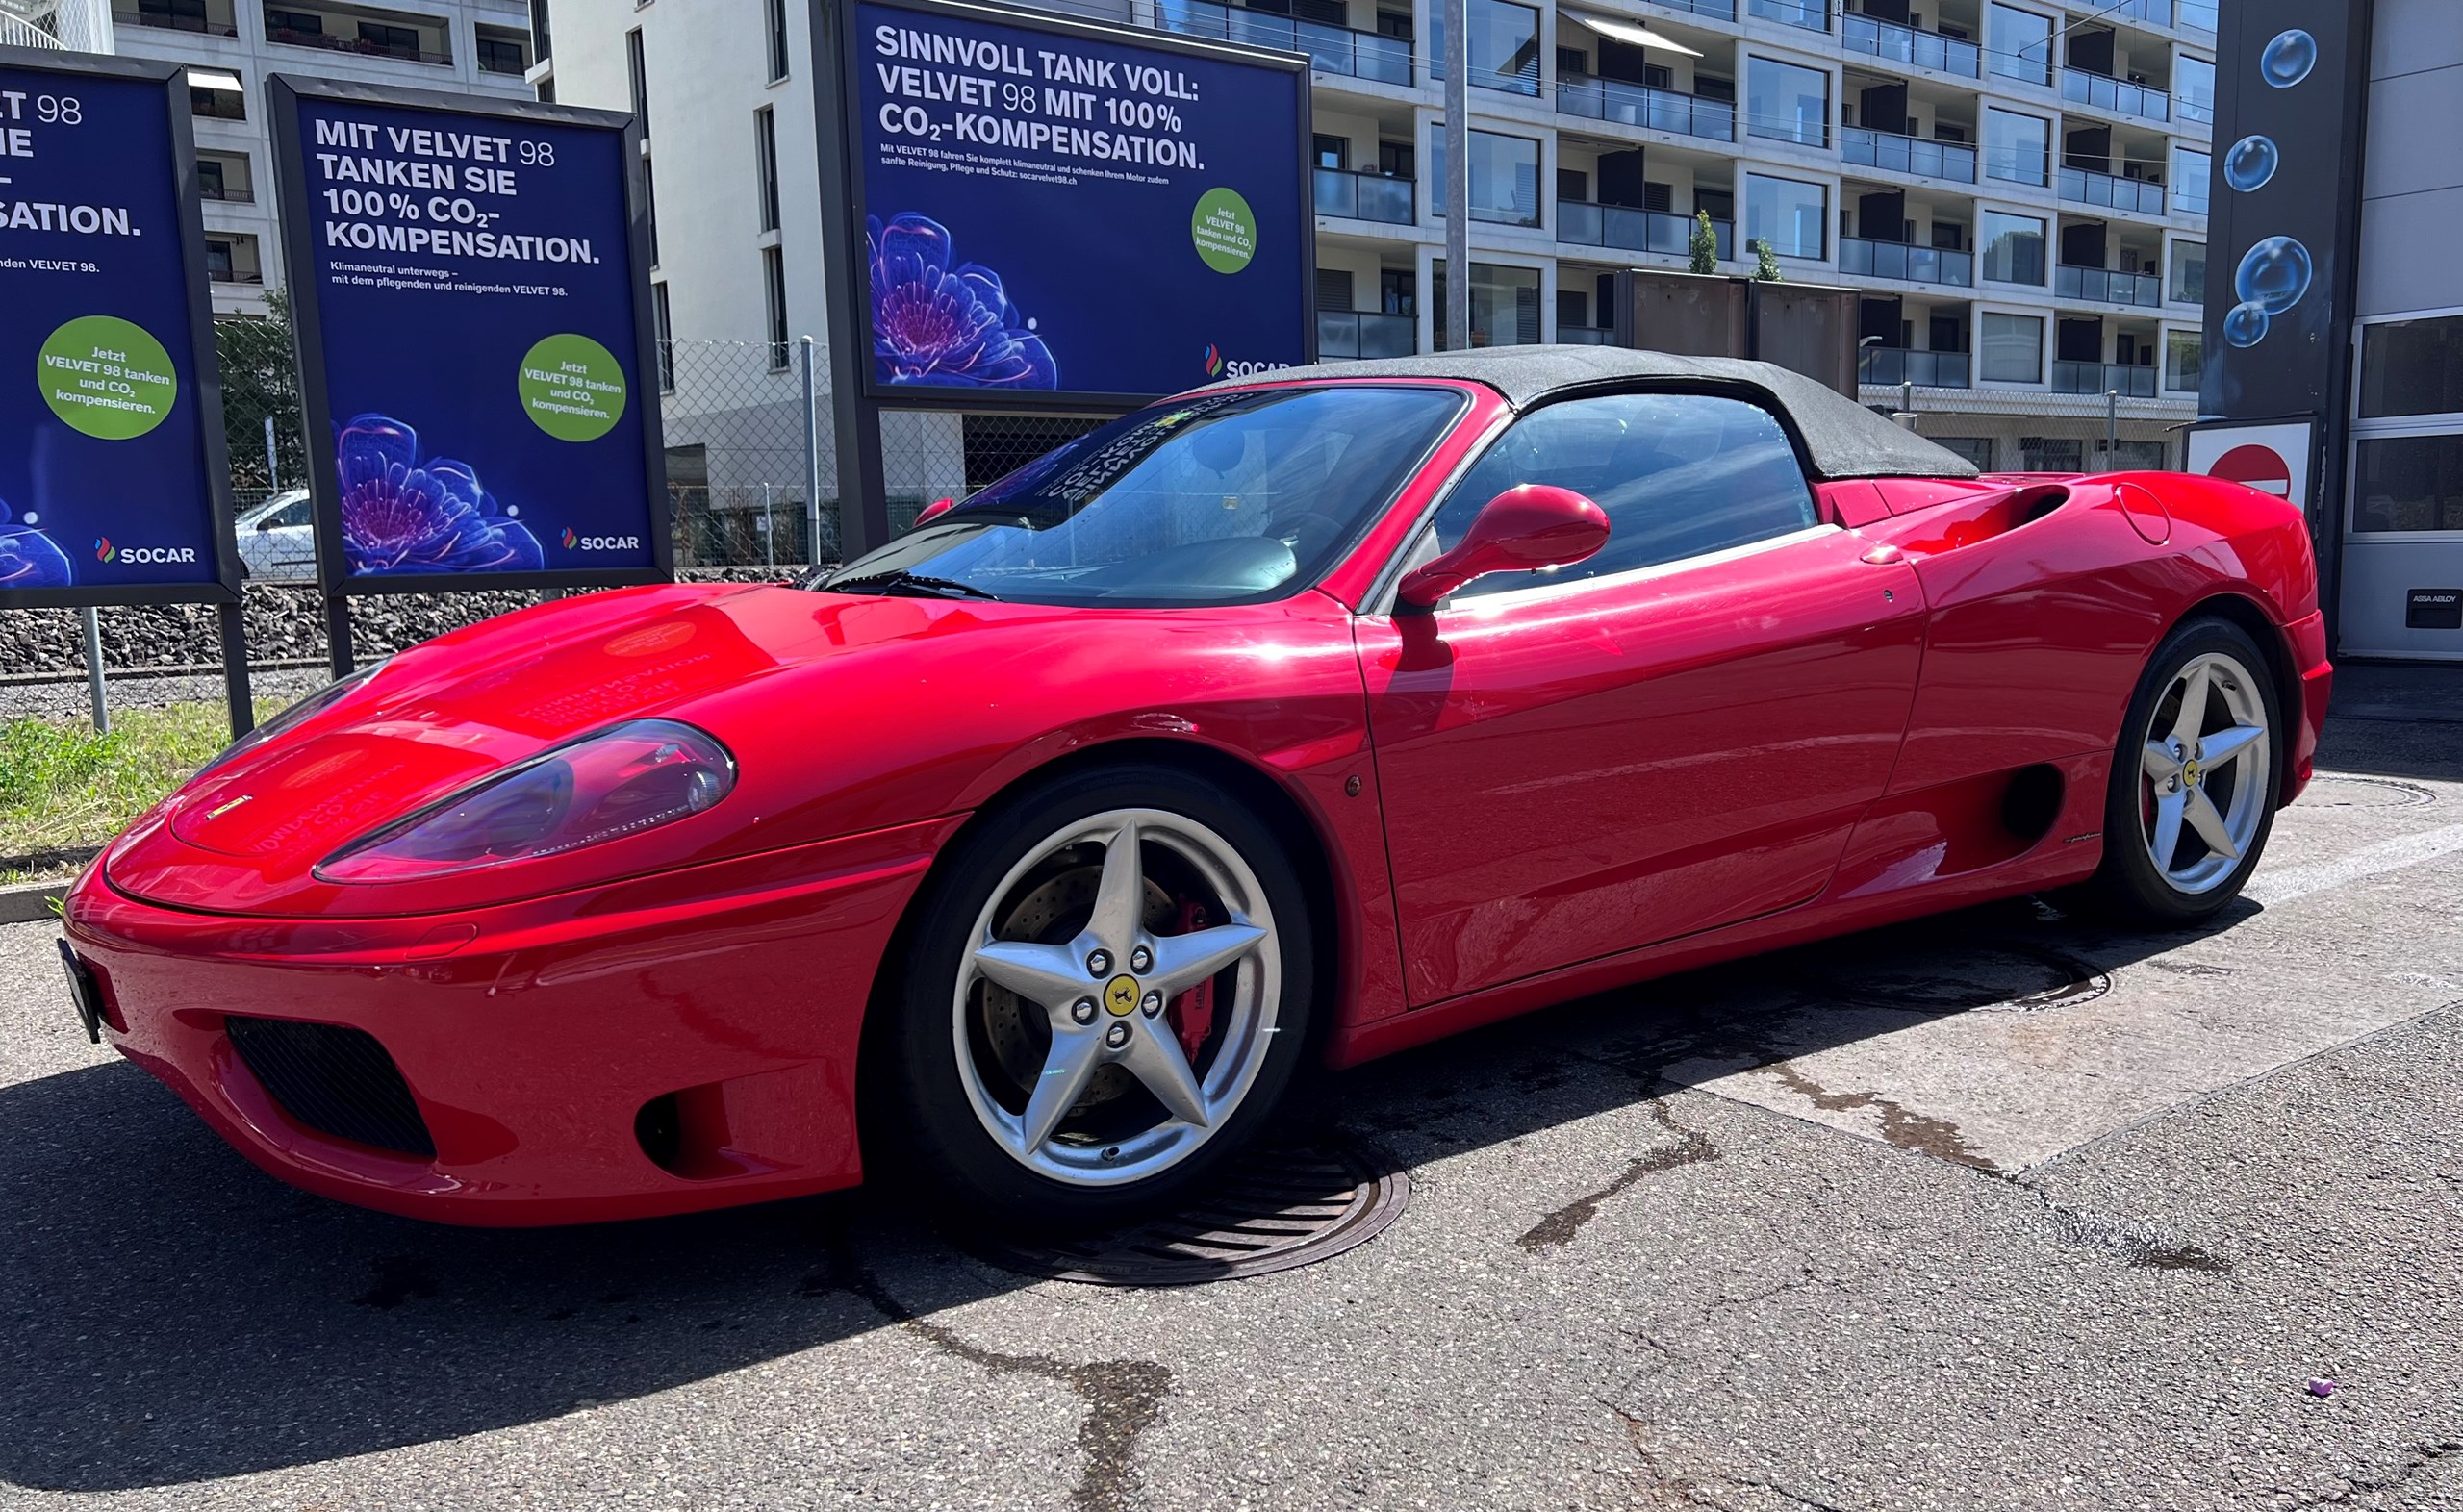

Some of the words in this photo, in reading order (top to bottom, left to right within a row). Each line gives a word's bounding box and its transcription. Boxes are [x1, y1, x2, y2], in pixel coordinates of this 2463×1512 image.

[876, 25, 1033, 77] SINNVOLL
[1038, 50, 1118, 88] TANK
[1123, 63, 1199, 101] VOLL:
[876, 63, 997, 108] VELVET
[1003, 83, 1037, 113] 98
[1045, 88, 1097, 121] MIT
[37, 94, 82, 125] 98
[316, 119, 378, 150] MIT
[387, 127, 511, 163] VELVET
[519, 140, 555, 167] 98
[316, 153, 455, 190] TANKEN
[464, 167, 517, 195] SIE
[880, 143, 894, 153] Mit
[896, 144, 927, 156] VELVET
[928, 149, 939, 158] 98
[941, 150, 964, 161] fahren
[966, 153, 978, 162] Sie
[979, 155, 1012, 166] komplett
[1013, 159, 1055, 171] klimaneutral
[1072, 166, 1104, 177] schenken
[1105, 170, 1124, 180] Ihrem
[1126, 172, 1145, 182] Motor
[1147, 175, 1169, 185] zudem
[881, 157, 906, 165] sanfte
[908, 158, 949, 171] Reinigung,
[950, 163, 974, 174] Pflege
[991, 167, 1018, 178] Schutz:
[1020, 172, 1078, 185] socarvelvet98.ch
[1217, 207, 1235, 220] Jetzt
[1197, 225, 1222, 239] tanken
[1223, 235, 1236, 243] und
[1206, 215, 1234, 231] VELVET
[1235, 224, 1245, 235] 98
[325, 221, 600, 264] KOMPENSATION.
[1196, 237, 1250, 260] kompensieren.
[29, 259, 77, 271] VELVET
[80, 262, 100, 272] 98.
[330, 262, 395, 274] Klimaneutral
[398, 267, 449, 279] unterwegs
[332, 274, 348, 284] mit
[351, 275, 374, 285] dem
[376, 277, 431, 289] pflegenden
[434, 282, 452, 290] und
[455, 282, 510, 293] reinigenden
[513, 285, 550, 295] VELVET
[552, 287, 568, 296] 98.
[91, 346, 126, 363] Jetzt
[45, 354, 101, 373] VELVET
[103, 364, 121, 377] 98
[124, 367, 169, 385] tanken
[560, 361, 587, 374] Jetzt
[79, 379, 105, 391] und
[524, 368, 568, 385] VELVET
[569, 376, 583, 387] 98
[586, 379, 621, 393] tanken
[56, 389, 156, 414] kompensieren.
[550, 390, 571, 399] und
[532, 398, 610, 419] kompensieren.
[581, 536, 639, 550] SOCAR
[120, 547, 196, 564] SOCAR
